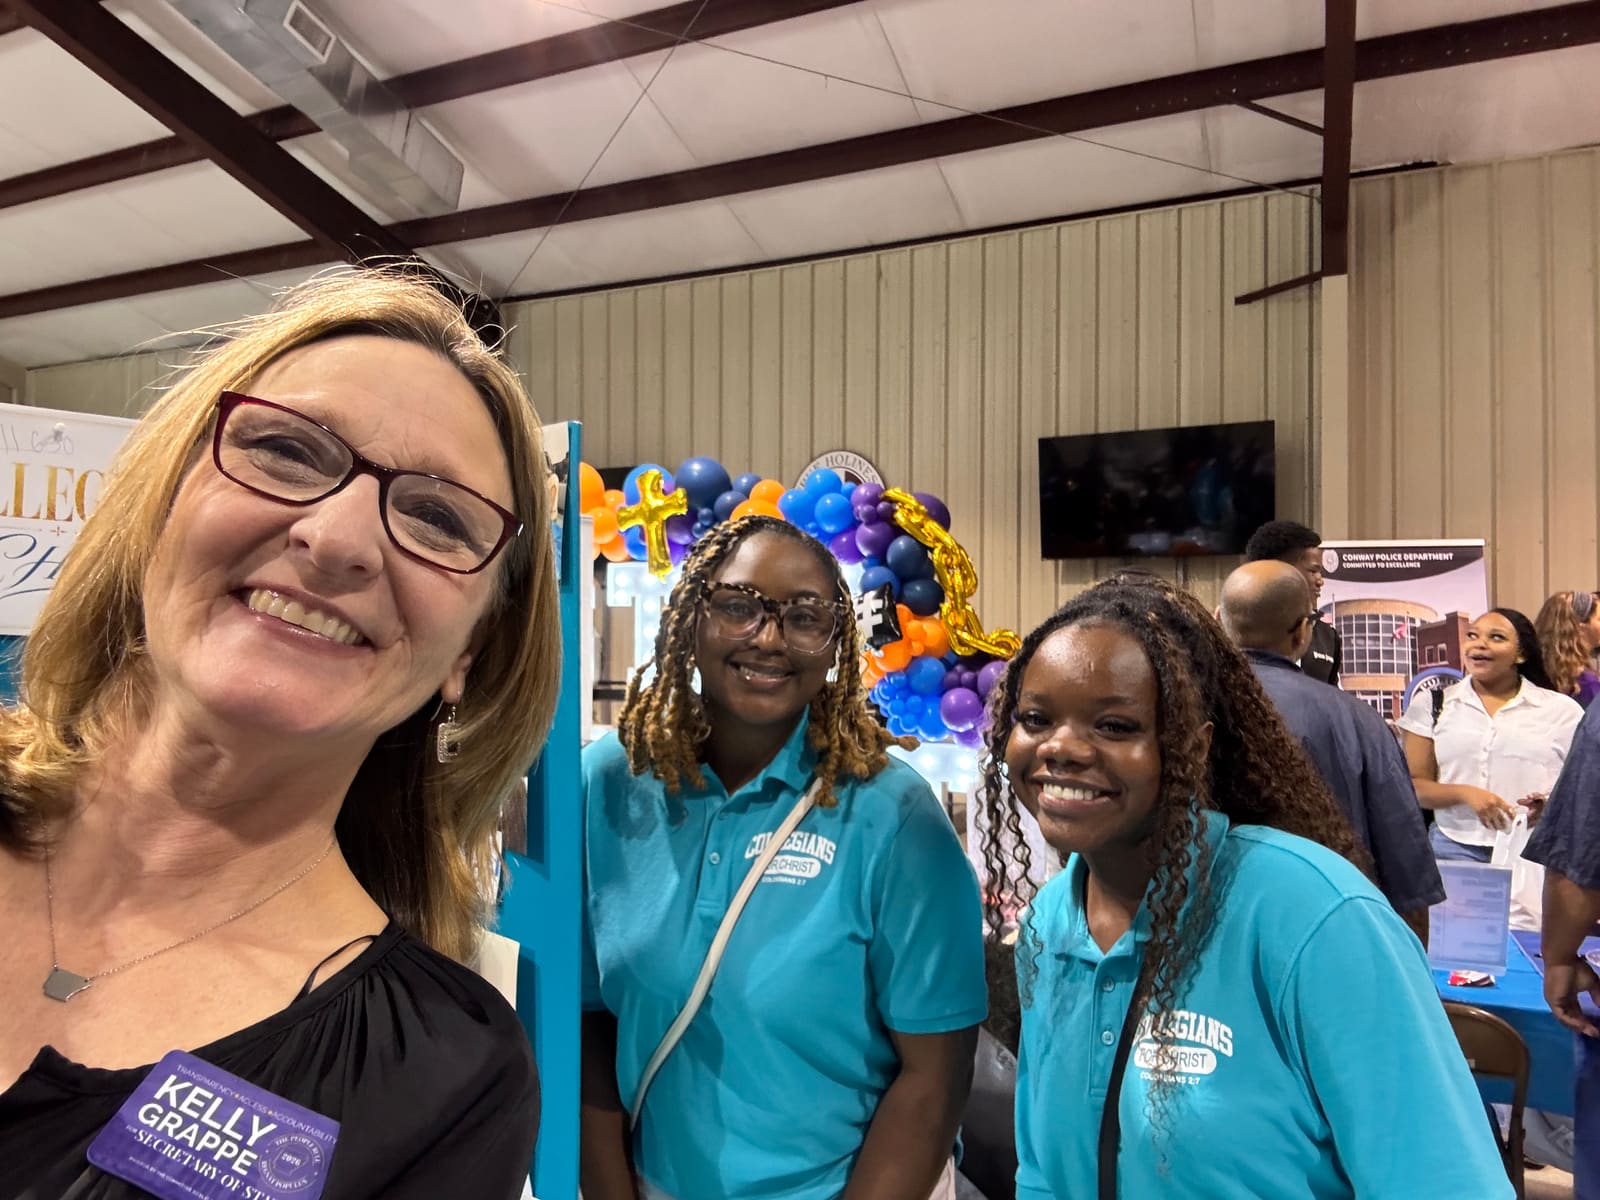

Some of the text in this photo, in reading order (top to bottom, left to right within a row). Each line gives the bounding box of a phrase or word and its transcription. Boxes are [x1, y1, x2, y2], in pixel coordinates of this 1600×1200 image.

[1342, 552, 1454, 561] CONWAY POLICE DEPARTMENT
[1386, 561, 1421, 569] EXCELLENCE
[744, 831, 836, 865] COEGIANS
[778, 859, 815, 873] CHRIST
[153, 1074, 278, 1148] KELLY
[176, 1063, 338, 1145] TRANSPARENCY ACCESS ACCOUNTABILITY
[134, 1129, 222, 1180] SECRETARY
[220, 1174, 246, 1192] OF
[138, 1103, 258, 1176] GRAPPE
